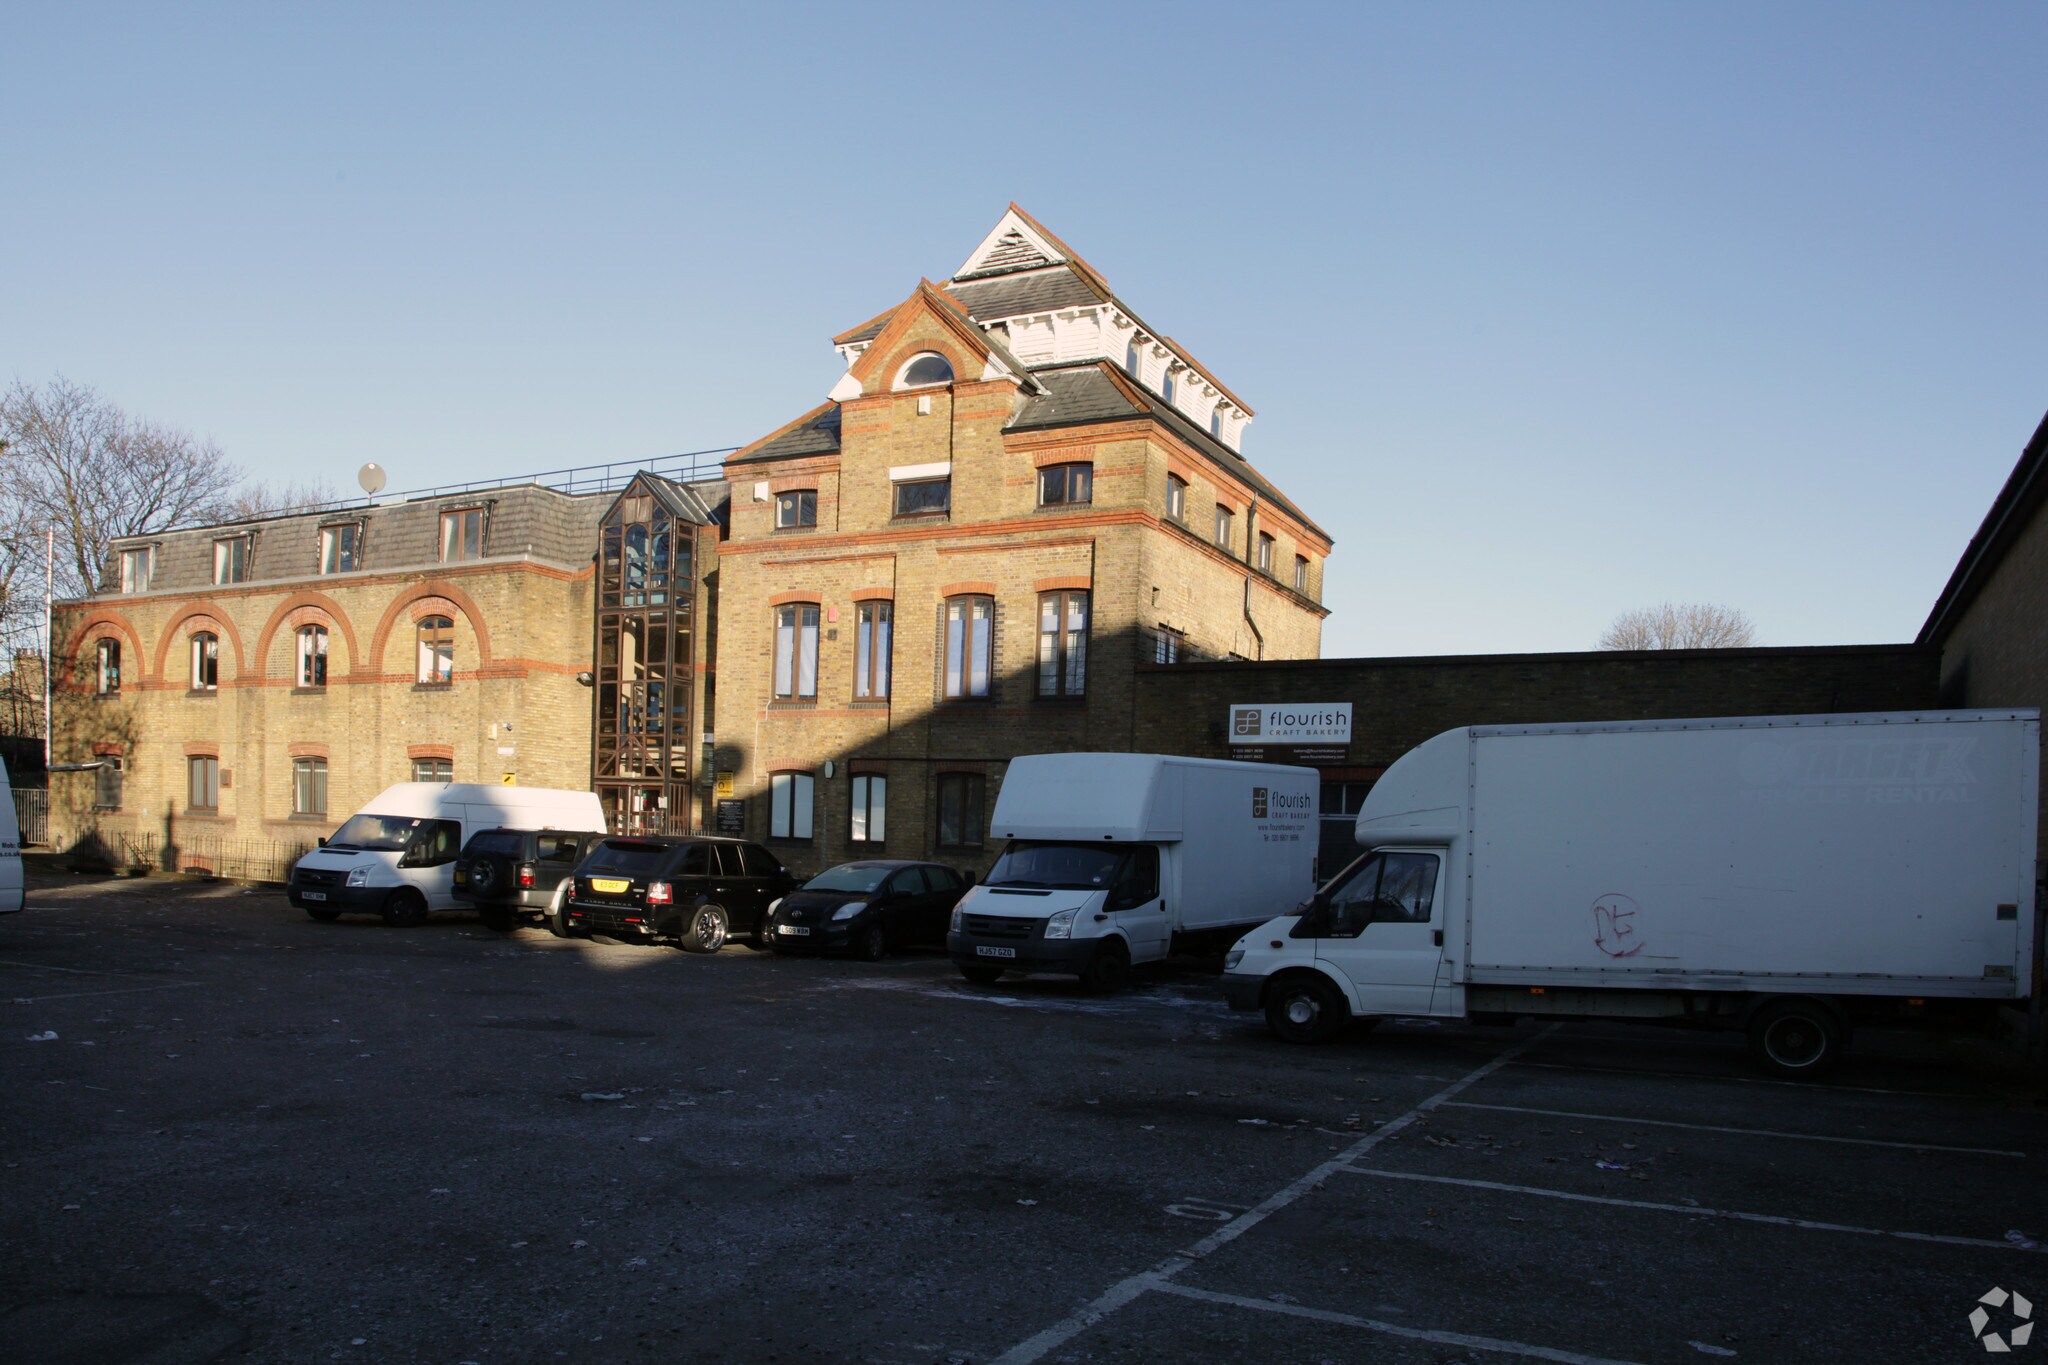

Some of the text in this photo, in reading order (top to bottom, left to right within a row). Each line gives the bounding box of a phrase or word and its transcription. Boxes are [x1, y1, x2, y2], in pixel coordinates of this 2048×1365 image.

[1269, 711, 1347, 726] flourish
[1272, 791, 1311, 809] flourish
[1865, 786, 1979, 804] RENTAL
[1290, 812, 1310, 820] BAKERY
